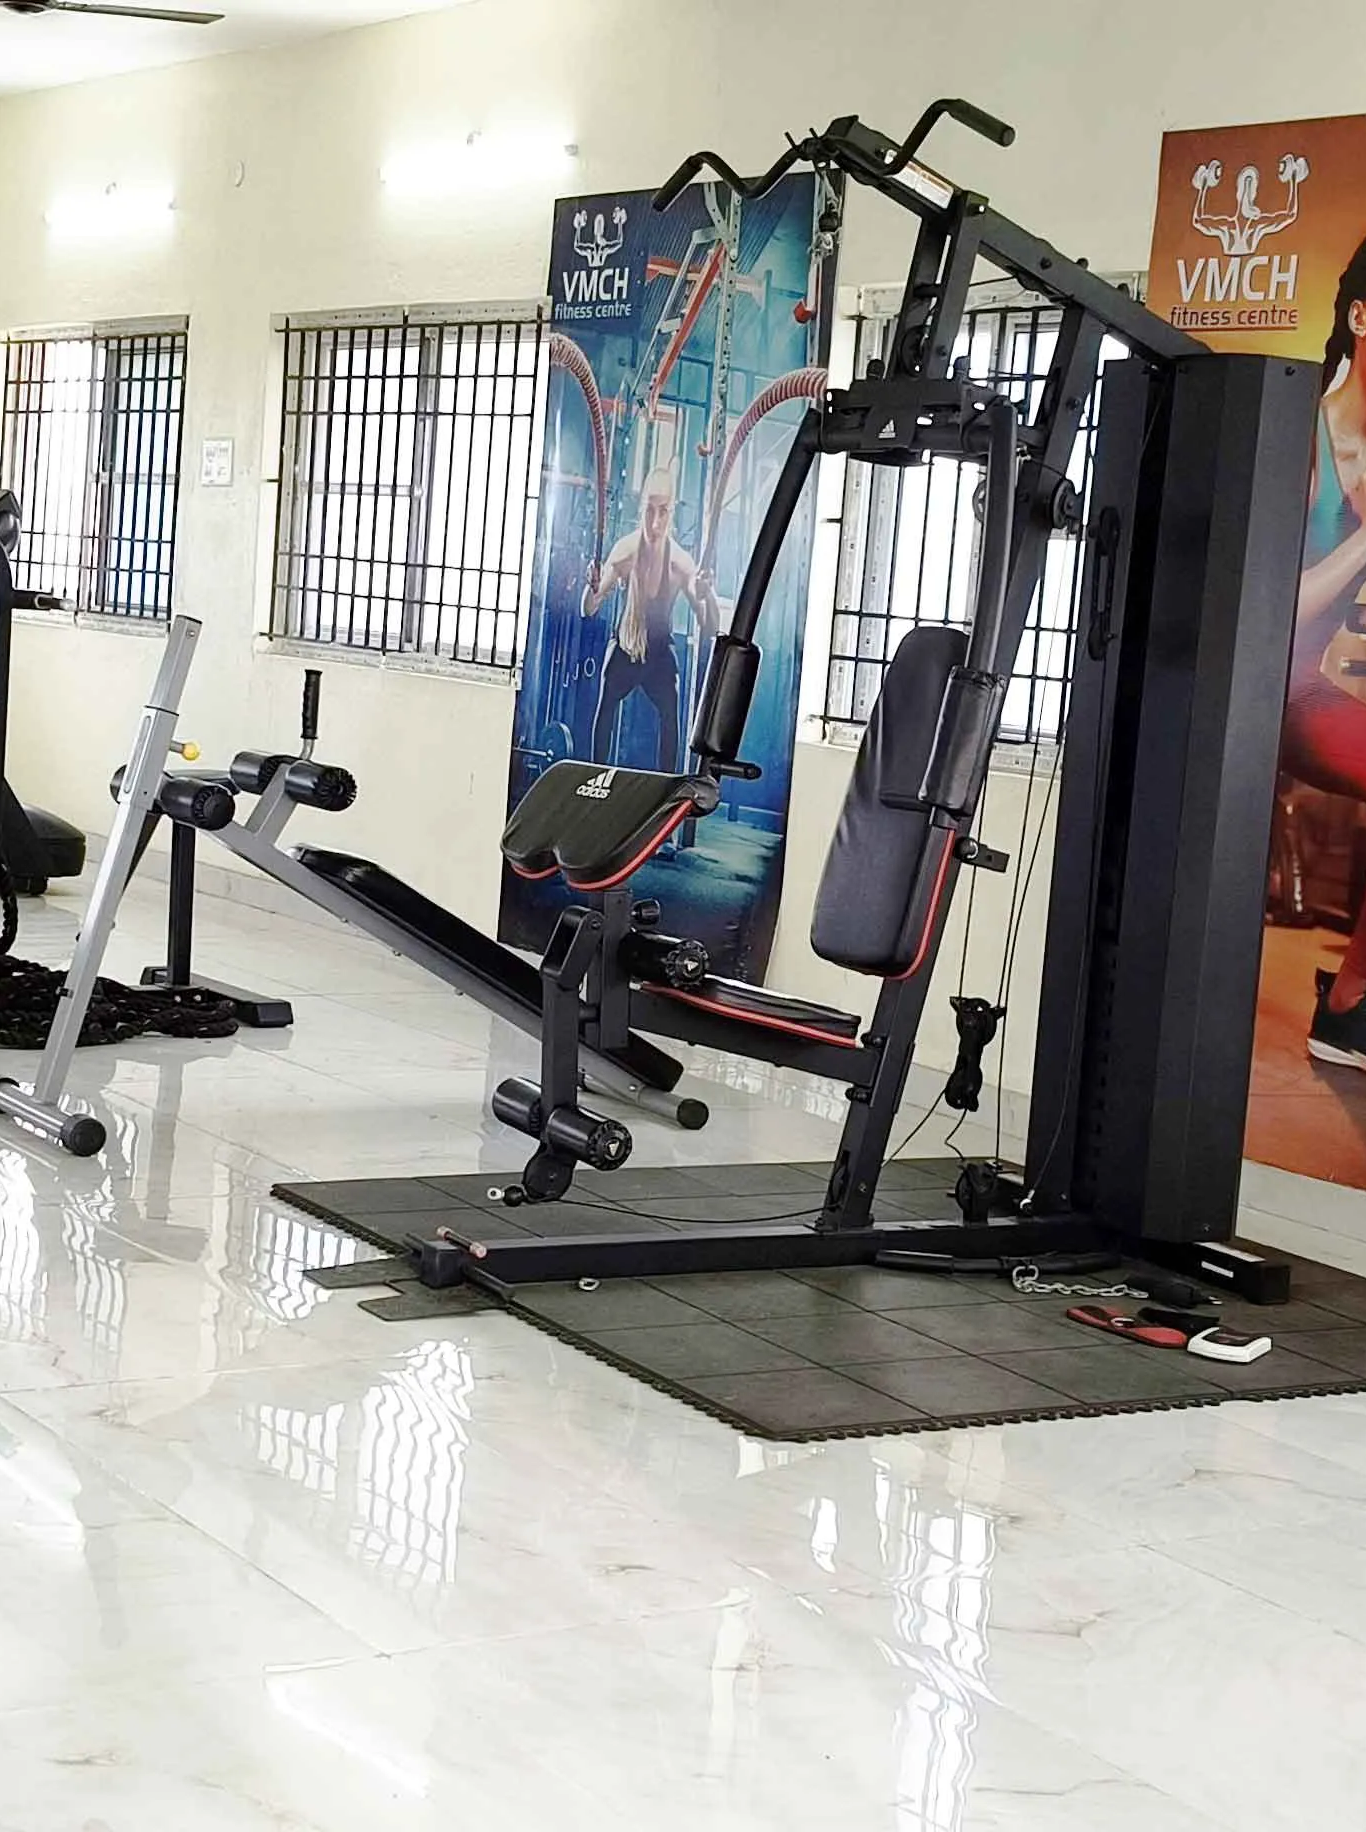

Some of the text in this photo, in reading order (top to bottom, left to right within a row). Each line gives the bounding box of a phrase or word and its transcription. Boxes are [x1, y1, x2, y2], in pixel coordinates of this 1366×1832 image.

[562, 267, 630, 303] VMCH
[1177, 254, 1299, 303] VMCH
[555, 301, 632, 320] fitness centre
[1170, 303, 1298, 326] fitness centre
